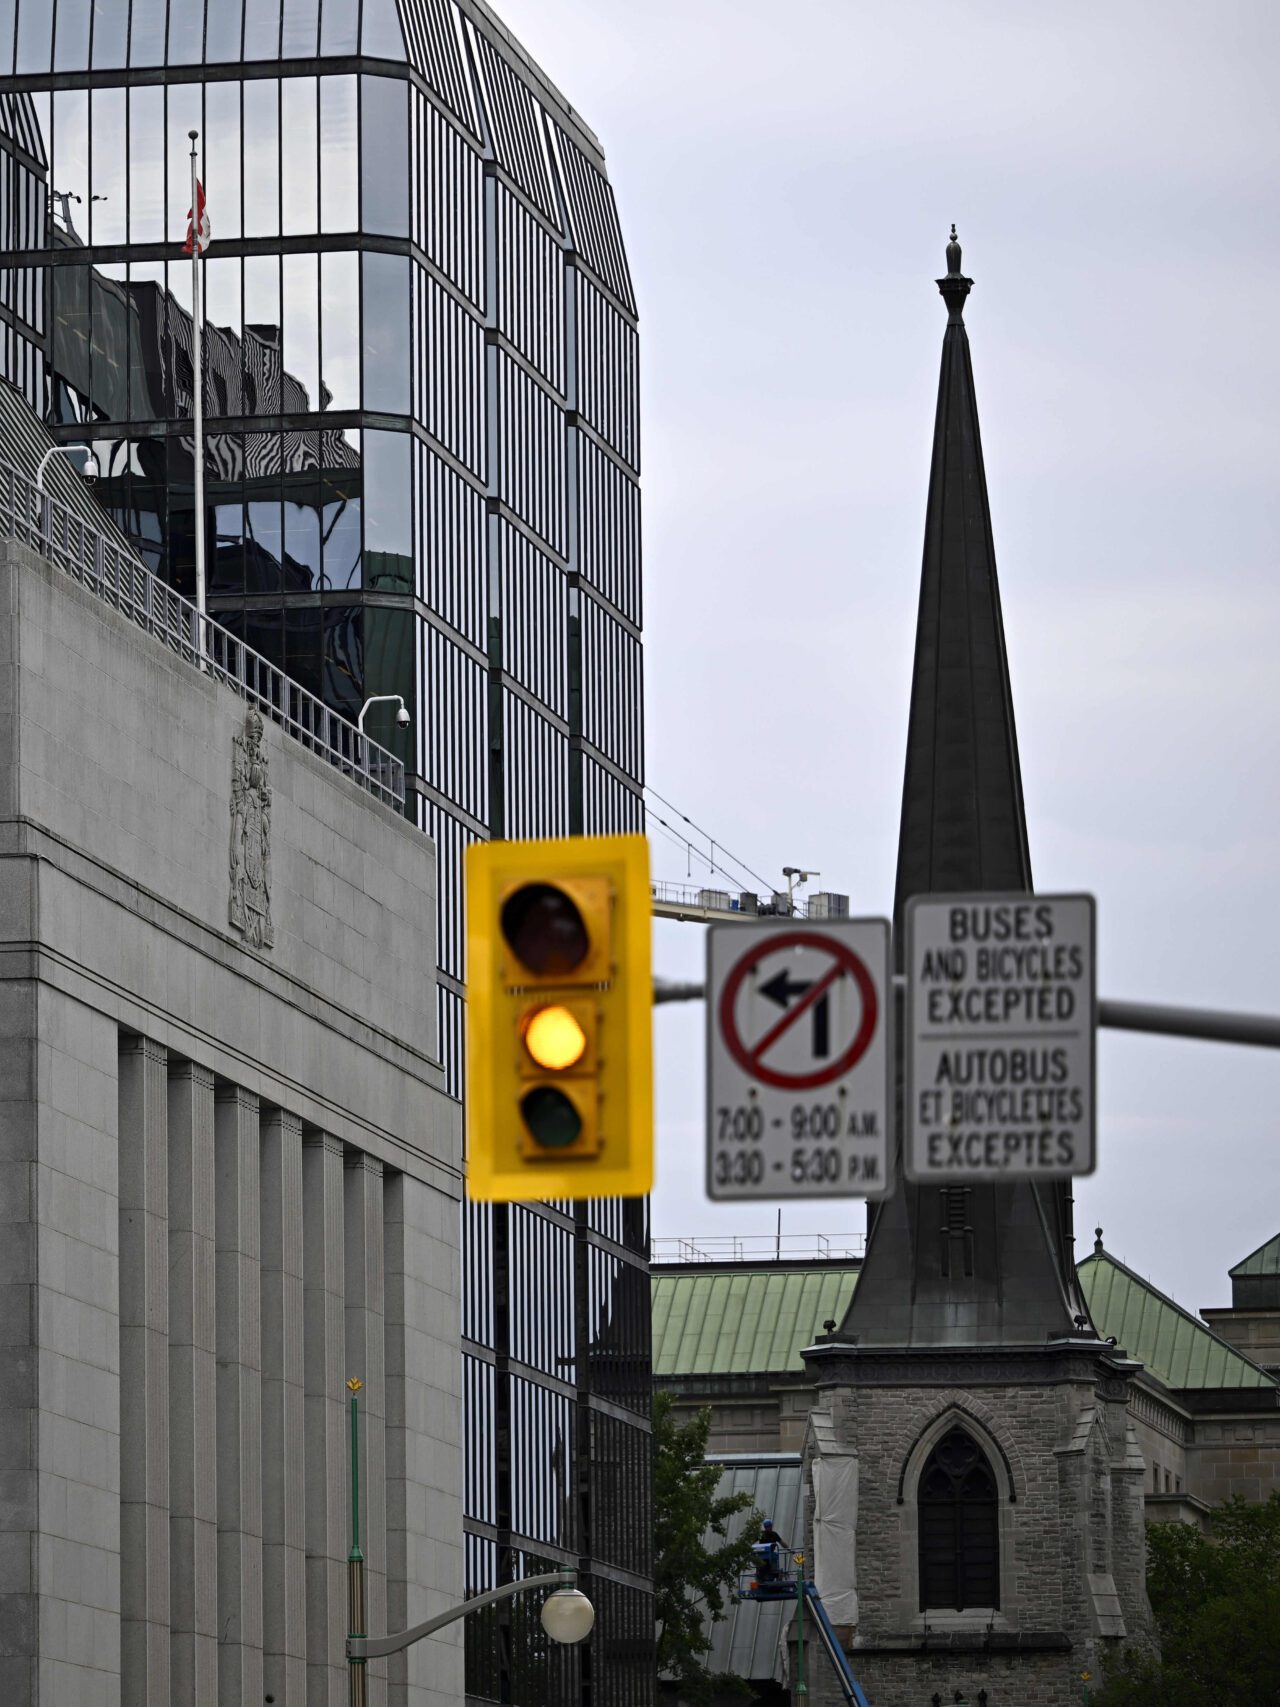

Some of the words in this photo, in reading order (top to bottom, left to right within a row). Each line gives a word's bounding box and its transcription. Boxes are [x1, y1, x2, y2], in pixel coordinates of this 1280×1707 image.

[949, 905, 1053, 943] BUSES
[921, 950, 966, 981] AND
[976, 946, 1083, 981] BICYCLES
[928, 987, 1074, 1023] EXCEPTED
[935, 1050, 1068, 1085] AUTOBUS
[717, 1106, 764, 1141] 7:00
[790, 1104, 840, 1140] 9:00
[920, 1091, 943, 1125] ET
[951, 1087, 1083, 1124] BICYCLETTES
[716, 1150, 764, 1185] 3:30
[790, 1148, 840, 1183] 5:30
